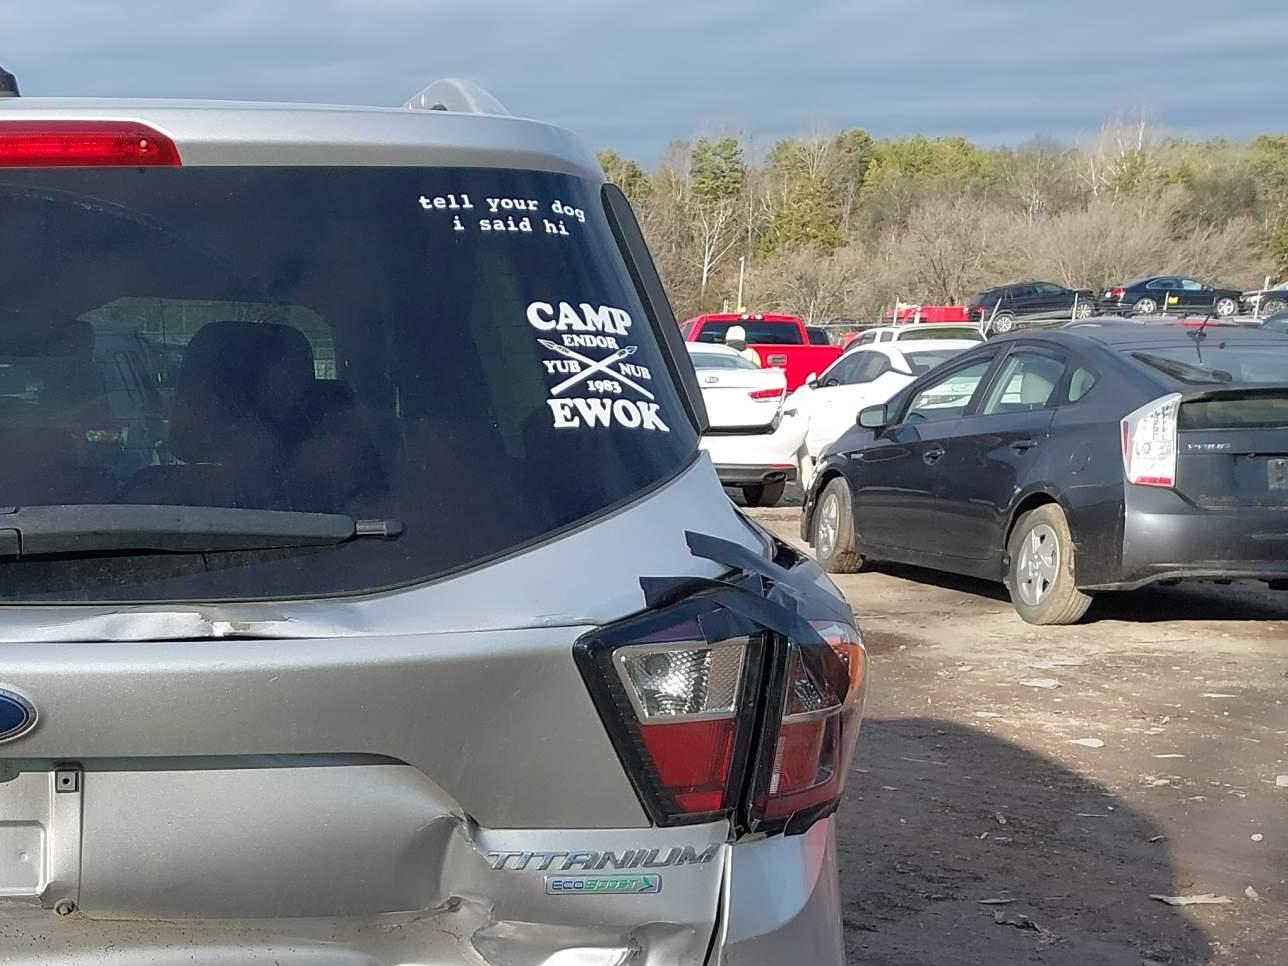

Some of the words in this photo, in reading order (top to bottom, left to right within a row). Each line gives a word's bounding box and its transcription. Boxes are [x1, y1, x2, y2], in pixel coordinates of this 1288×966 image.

[418, 194, 474, 209] tell
[486, 198, 539, 213] your
[551, 200, 586, 222] dog
[453, 215, 465, 231] i
[479, 216, 533, 232] said
[544, 219, 570, 236] hi
[526, 301, 632, 336] CAMP
[562, 334, 620, 350] ENDOR
[543, 360, 581, 374] YUB
[618, 362, 652, 380] NUB
[586, 379, 623, 394] 1983
[547, 398, 670, 432] EWOK
[487, 843, 721, 871] TITANIUM
